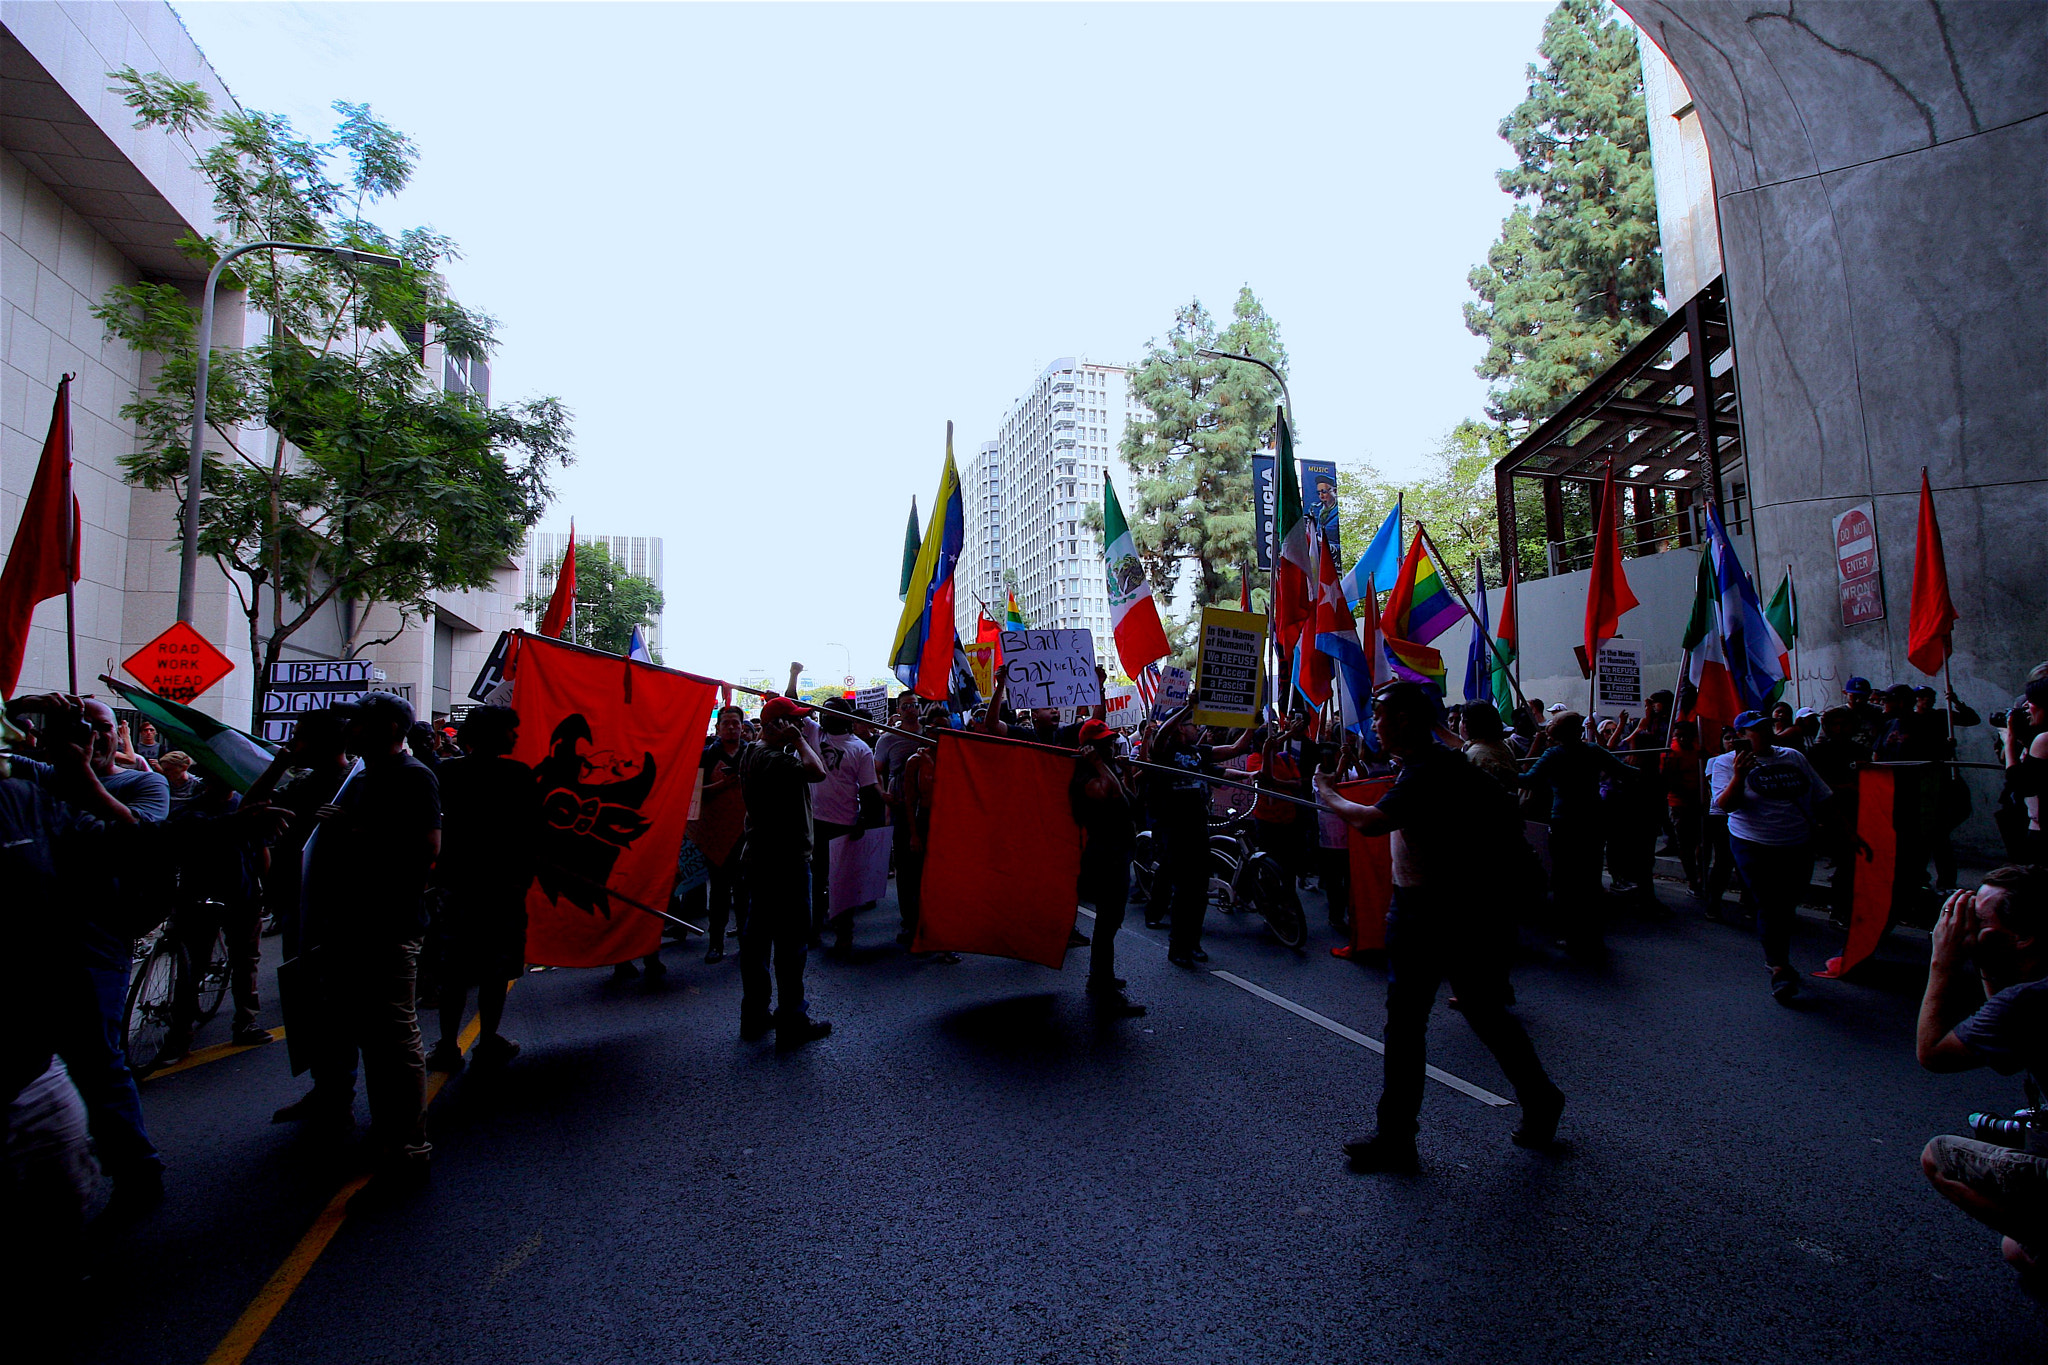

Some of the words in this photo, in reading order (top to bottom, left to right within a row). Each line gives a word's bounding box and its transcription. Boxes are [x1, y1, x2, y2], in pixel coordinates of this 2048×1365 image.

[1261, 467, 1274, 516] UCLA
[1840, 528, 1850, 542] DO
[1853, 520, 1867, 536] NOT
[1846, 556, 1868, 574] ENTER
[1841, 581, 1877, 600] WRONG
[1852, 601, 1872, 616] WAY
[1207, 626, 1215, 636] In
[1217, 627, 1231, 638] the
[1232, 629, 1255, 641] Name
[159, 644, 199, 654] ROAD
[1206, 638, 1214, 646] of
[1216, 638, 1256, 653] Humanity,
[158, 660, 200, 669] WORK
[1207, 650, 1220, 662] We
[1221, 653, 1256, 667] REFUSE
[1210, 665, 1220, 675] To
[1222, 666, 1250, 679] Accept
[1613, 667, 1638, 675] REFUSE
[153, 675, 202, 686] AHEAD
[1217, 679, 1247, 692] Fascist
[1105, 695, 1131, 713] UMP
[1211, 692, 1244, 704] America
